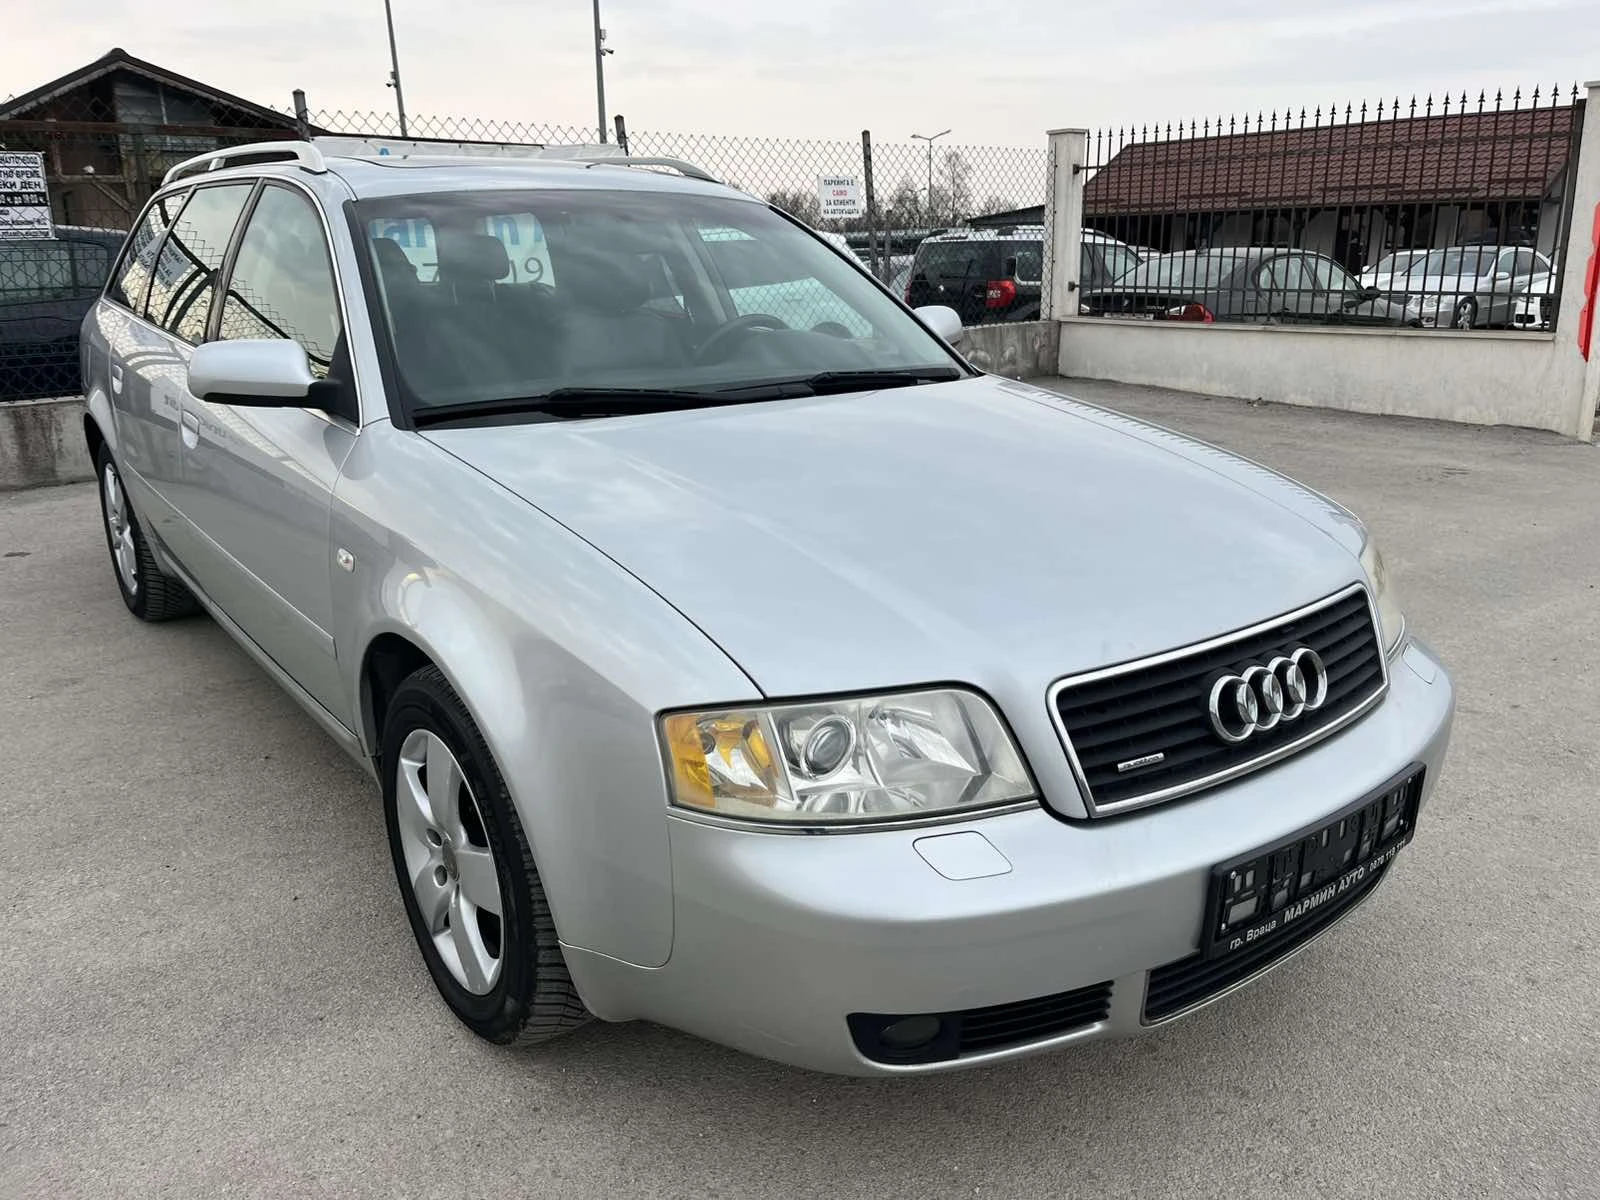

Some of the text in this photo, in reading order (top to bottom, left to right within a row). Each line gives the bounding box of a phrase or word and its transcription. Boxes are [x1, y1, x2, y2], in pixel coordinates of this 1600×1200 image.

[20, 181, 40, 190] ДЕН
[1229, 937, 1244, 951] гр.
[1246, 919, 1277, 942] Враца
[1284, 884, 1337, 924] МАРМИН
[1338, 866, 1365, 893] АУТО
